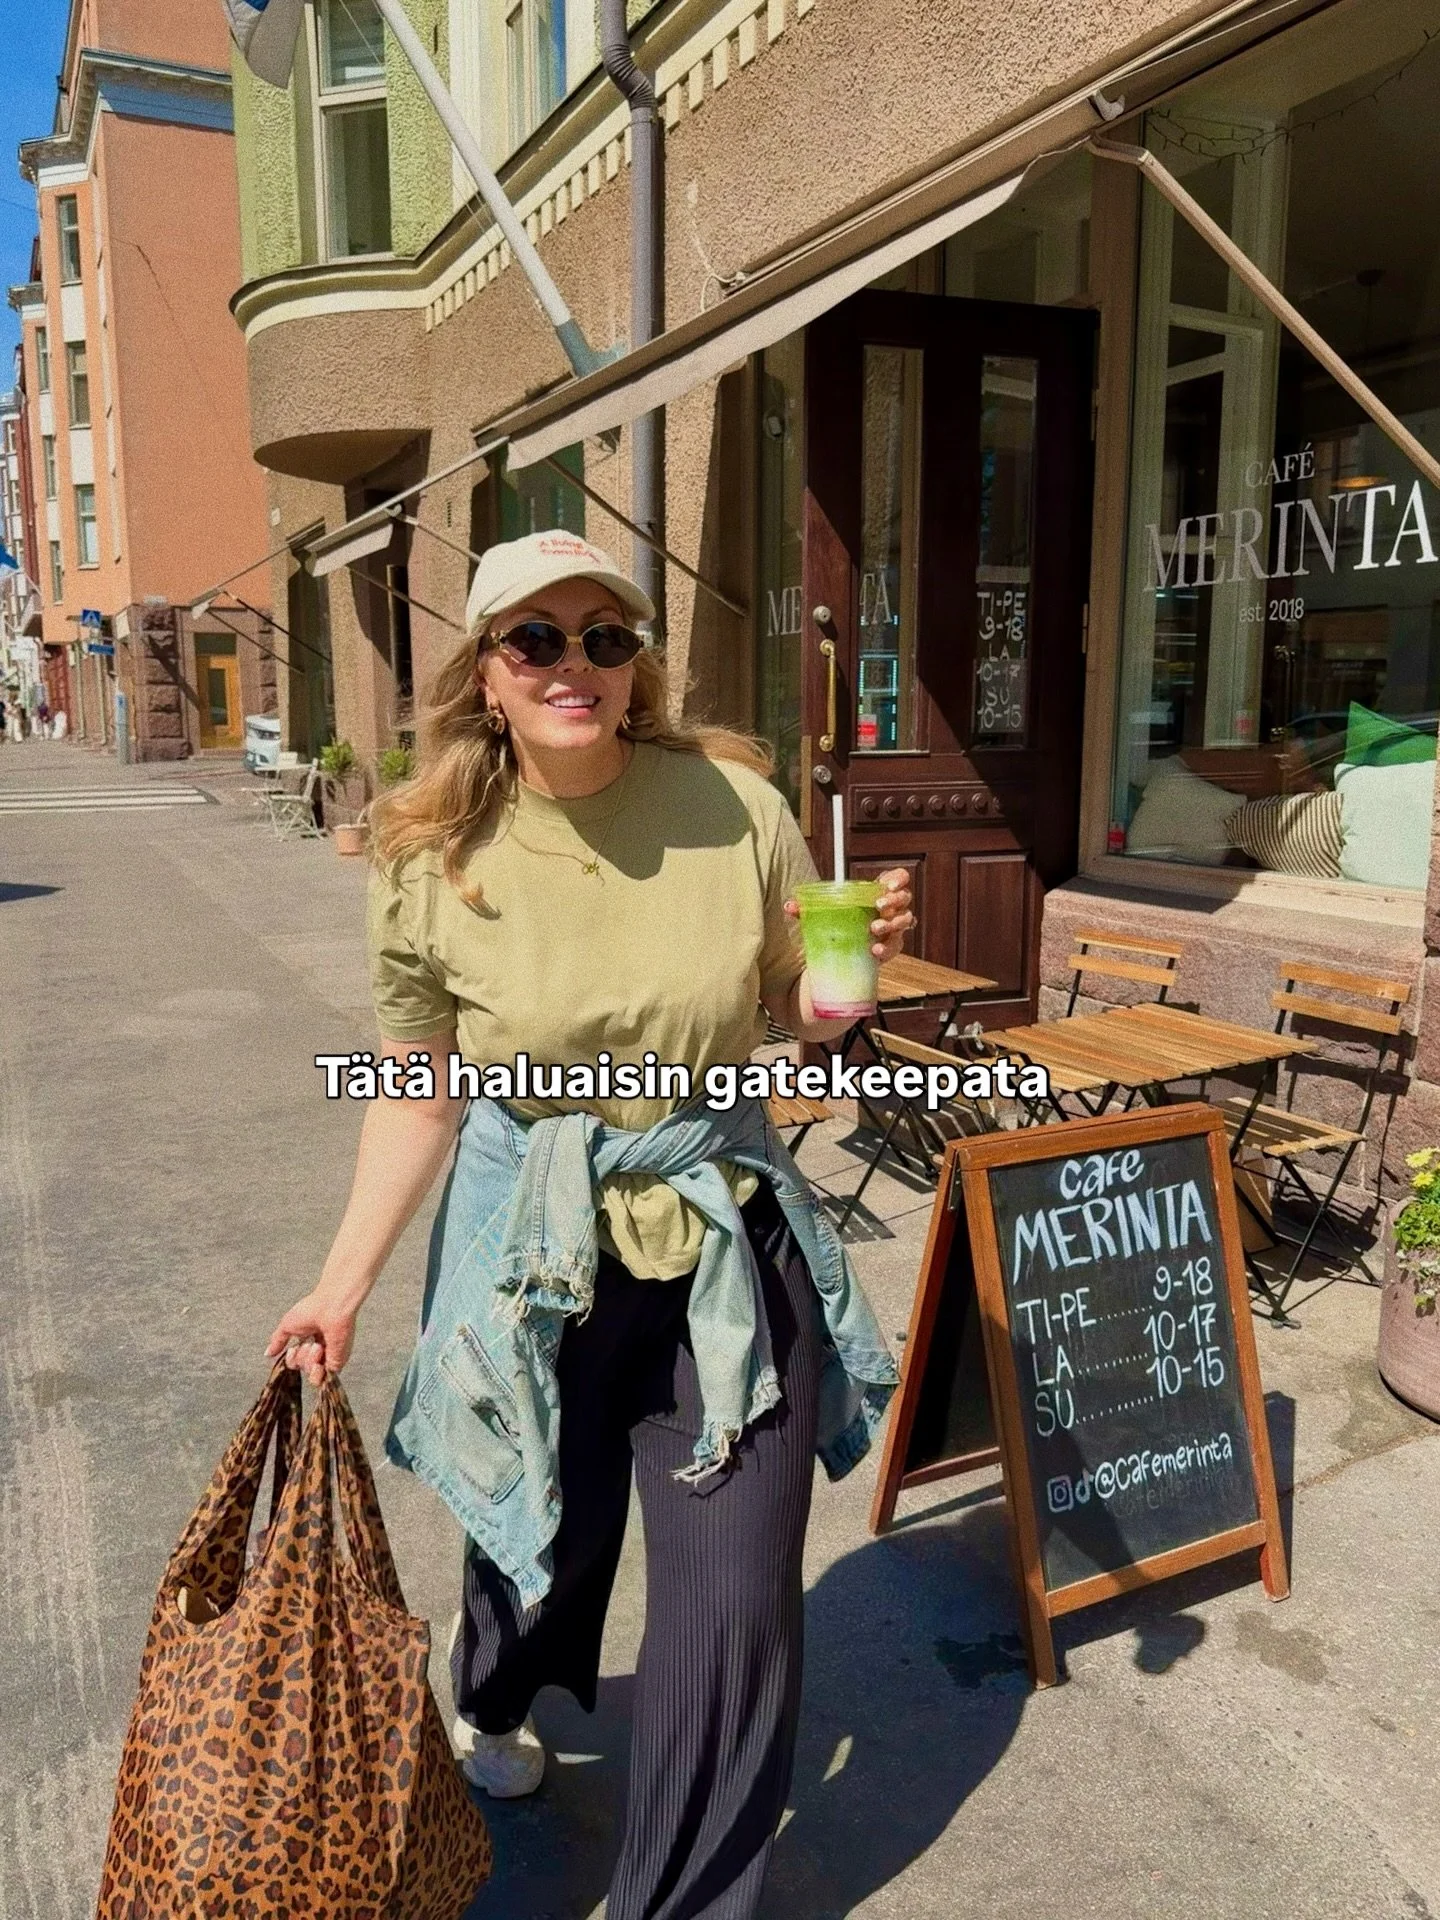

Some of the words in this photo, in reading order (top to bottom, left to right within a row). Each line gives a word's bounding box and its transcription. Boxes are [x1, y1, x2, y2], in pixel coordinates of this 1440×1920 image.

[1245, 442, 1316, 488] CAFÉ
[1143, 479, 1440, 593] MERINTA
[976, 590, 1027, 617] TI-PE
[1238, 603, 1265, 624] est.
[1268, 597, 1305, 622] 2018
[978, 615, 1025, 642] 9-18
[988, 643, 1010, 663] LA
[976, 662, 1021, 685] 10-17
[984, 685, 1010, 707] SU
[976, 703, 1022, 729] 10-15
[1013, 1180, 1212, 1285] MERINTA
[1153, 1256, 1214, 1302] 9-18
[1032, 1345, 1076, 1388] LA
[1143, 1302, 1217, 1355] 10-17
[1035, 1388, 1077, 1438] SU
[1146, 1346, 1226, 1398] 10-15
